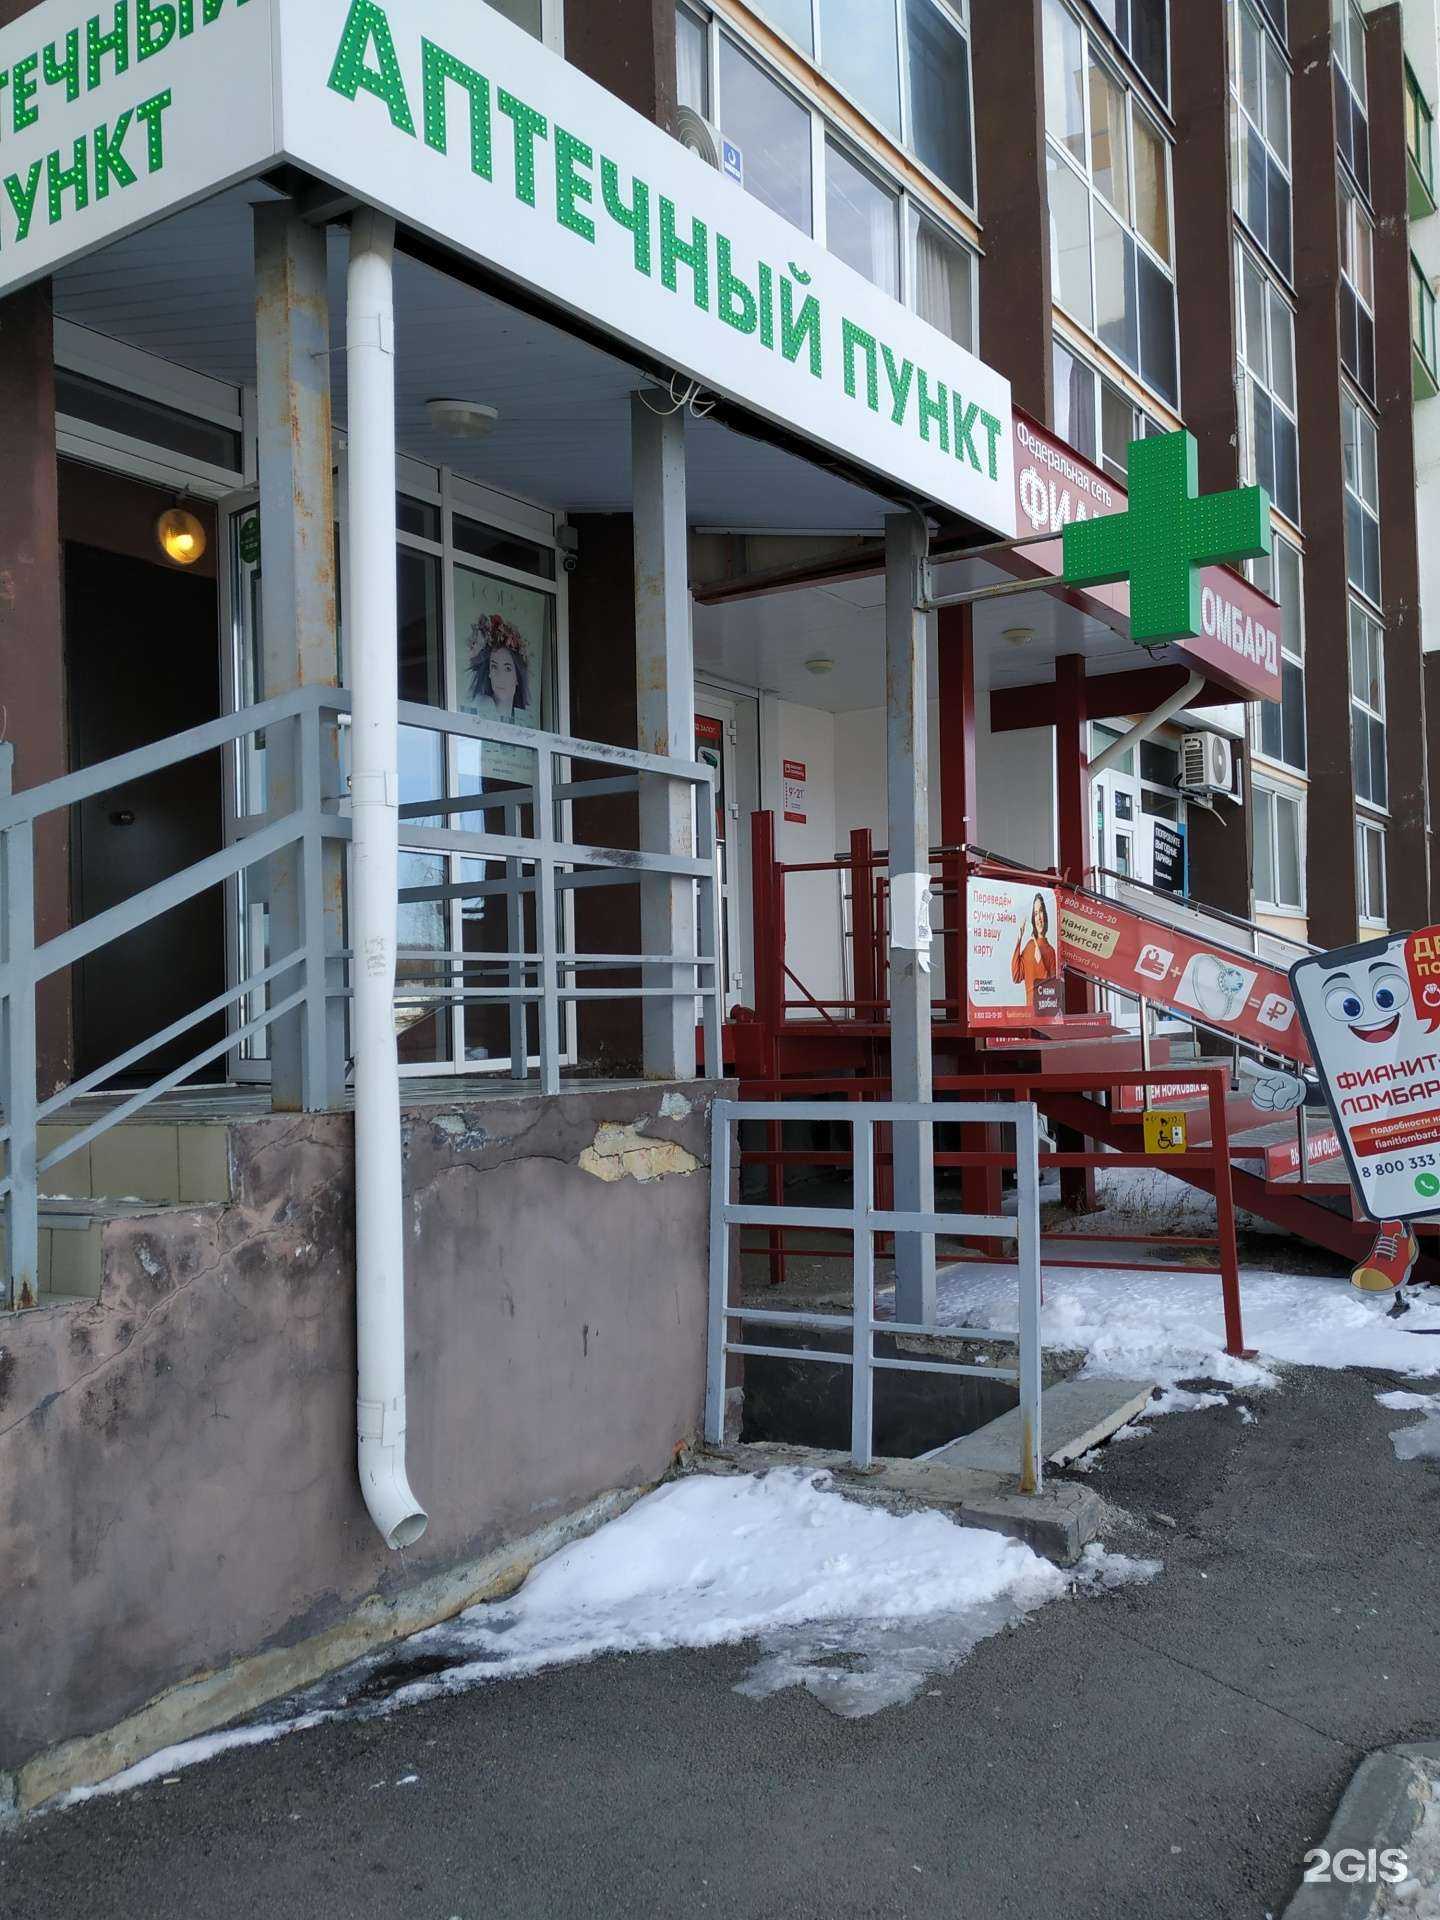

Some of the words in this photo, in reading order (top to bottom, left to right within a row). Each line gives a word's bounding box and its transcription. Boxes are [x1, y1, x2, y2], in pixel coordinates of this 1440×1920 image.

[0, 0, 250, 133] ЕЧНЫ
[327, 0, 823, 379] АПТЕЧНЫЙ
[842, 316, 1002, 482] ПУНКТ
[1016, 422, 1090, 492] Федеральная
[1091, 481, 1112, 508] сеть
[1020, 466, 1100, 534] ФИ
[1201, 586, 1278, 677] ОМБАРД
[973, 890, 1012, 909] Переведём
[1064, 899, 1079, 909] 800
[1080, 904, 1117, 924] 333-12-20
[973, 911, 995, 925] сумму
[996, 909, 1017, 924] займа
[1061, 917, 1088, 934] нами
[1090, 929, 1111, 942] всё
[973, 927, 982, 937] на
[983, 928, 1001, 941] вашу
[973, 944, 993, 958] карту
[1370, 1117, 1431, 1135] Подробности
[1362, 1167, 1371, 1178] 8
[1376, 1160, 1404, 1176] 800
[1409, 1154, 1436, 1169] 333
